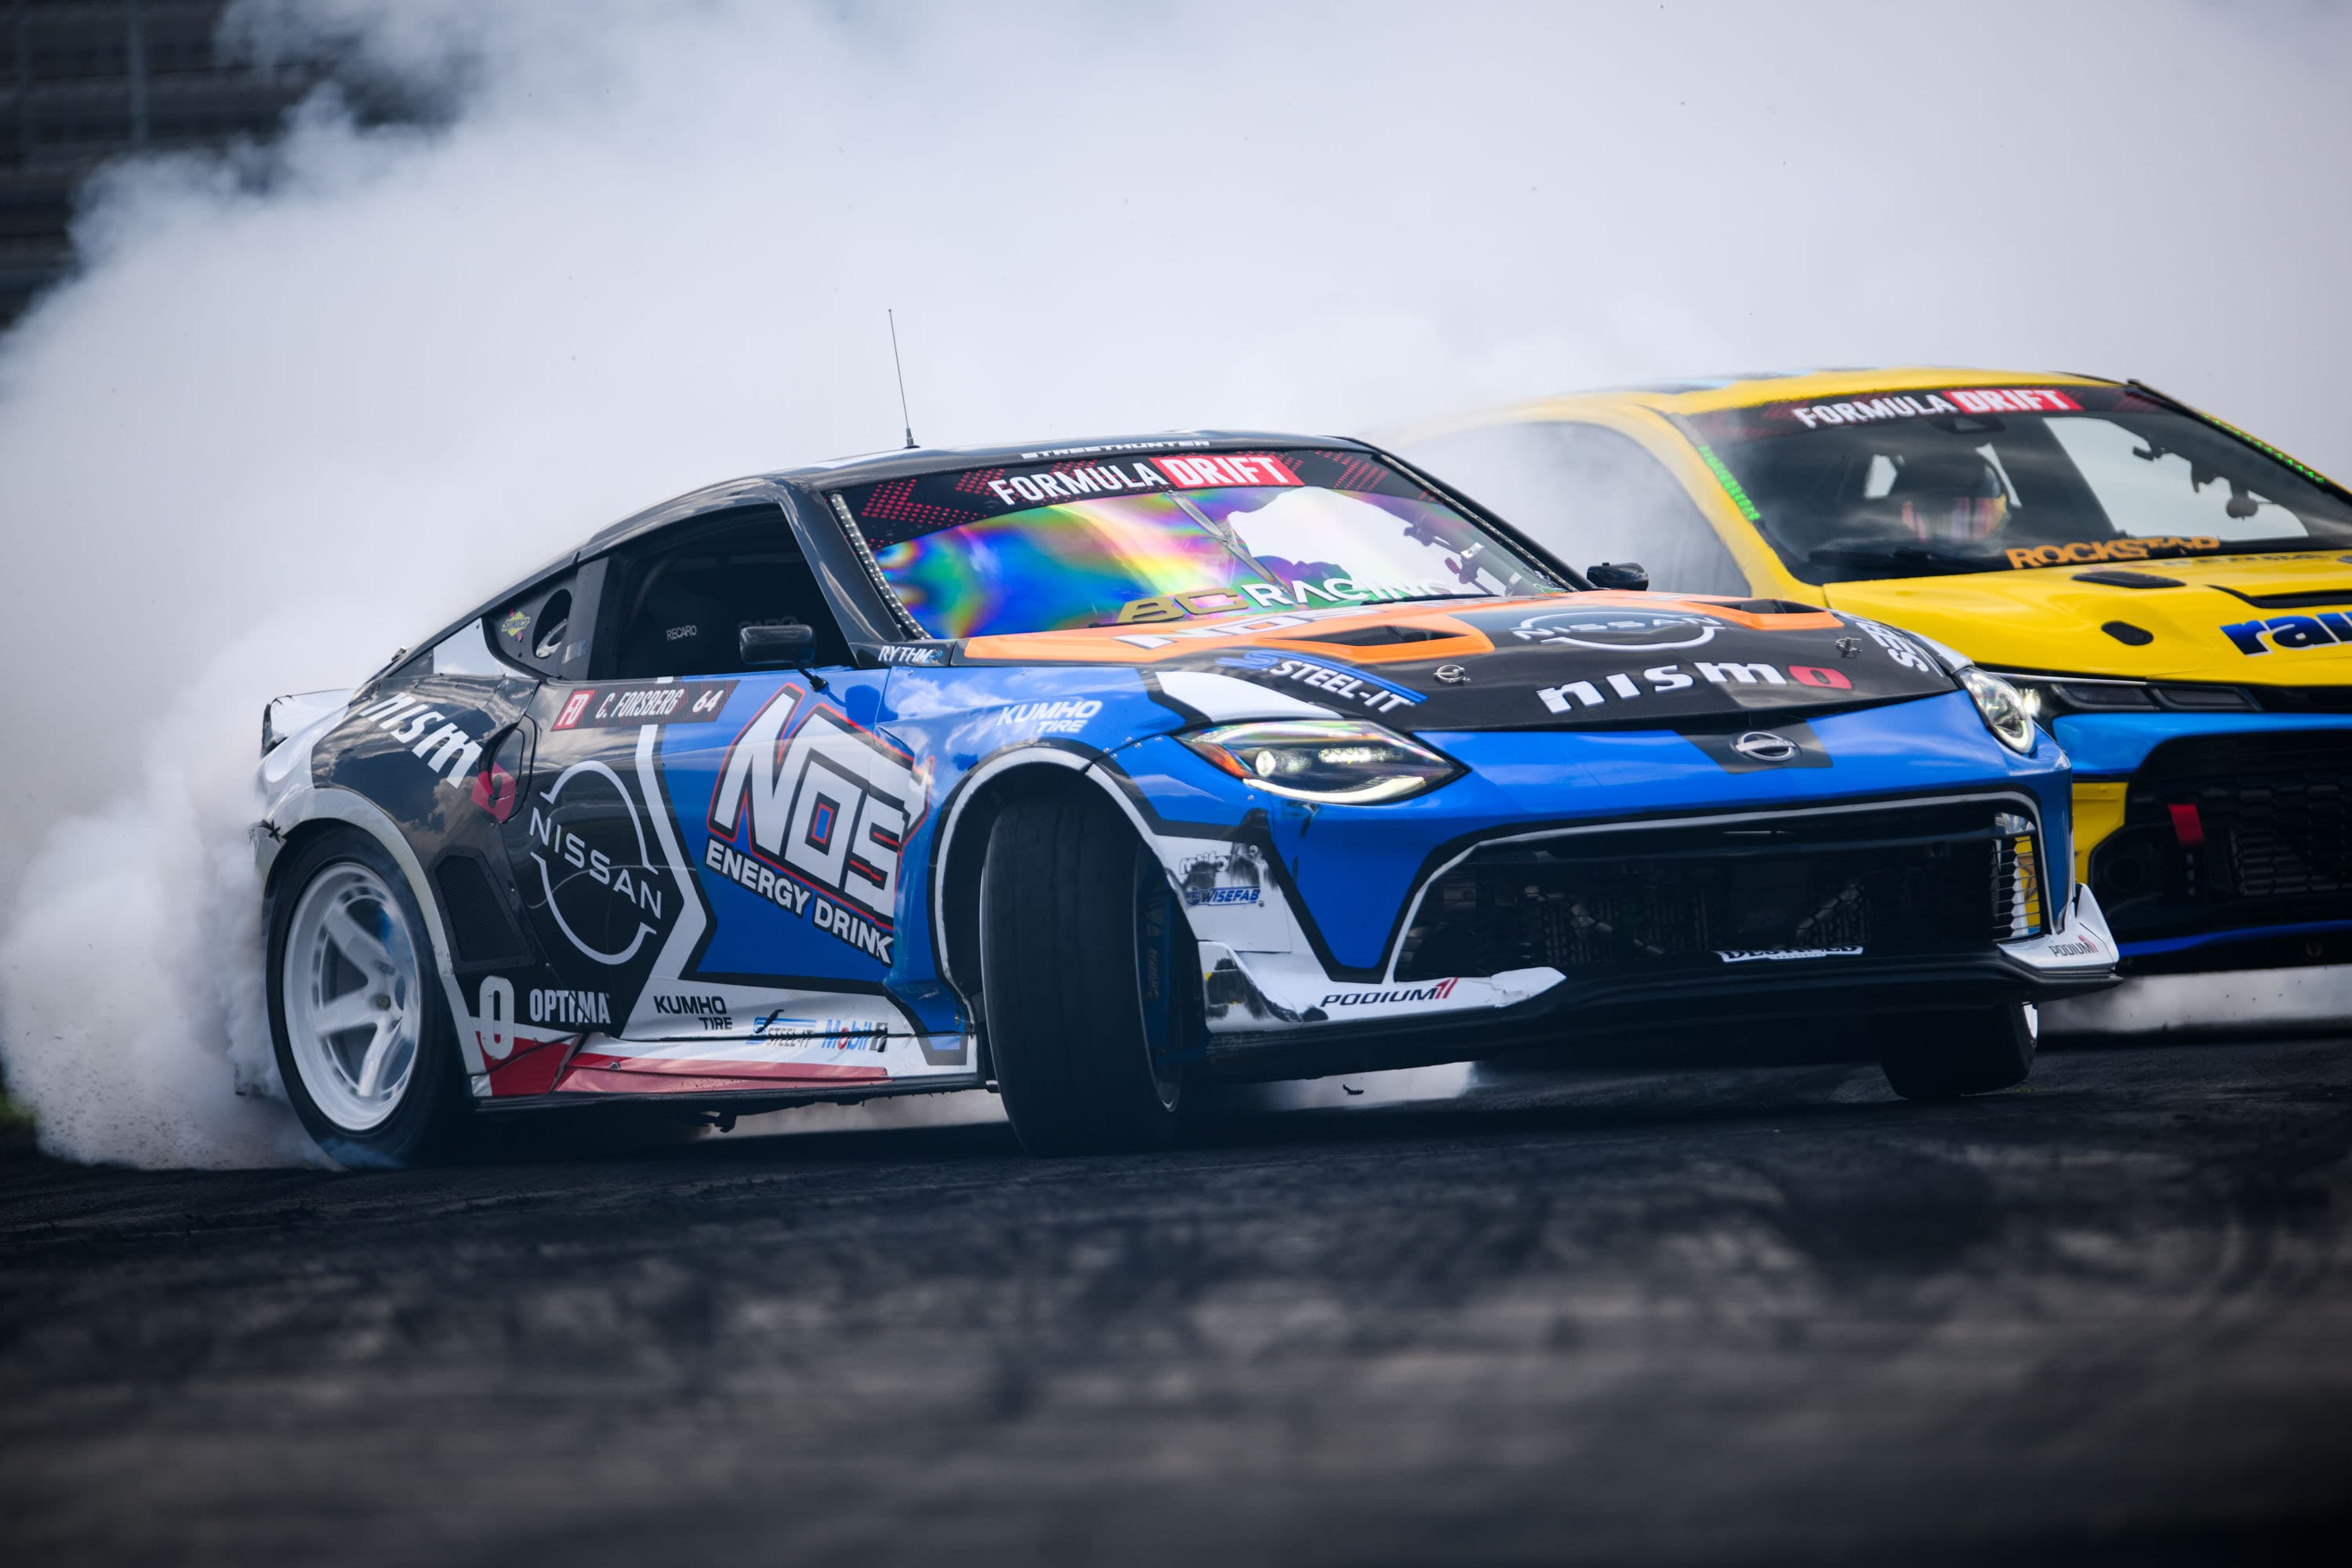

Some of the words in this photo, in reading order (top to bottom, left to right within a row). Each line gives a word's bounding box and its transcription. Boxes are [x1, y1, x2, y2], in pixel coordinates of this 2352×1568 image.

[1792, 394, 1959, 429] FORMULA
[1951, 389, 2071, 412] DRIFT
[1022, 441, 1210, 459] STREETHUNTER
[988, 462, 1171, 506] FORMULA
[1160, 456, 1289, 485] DRIFT
[1116, 588, 1248, 623] BC
[666, 625, 697, 641] RECARO
[1512, 616, 1722, 641] NISSAN
[2219, 612, 2352, 657] rai
[1269, 660, 1414, 713] STEEL-IT
[1535, 660, 1853, 715] nismo
[557, 693, 590, 726] FD
[595, 692, 615, 719] C.
[610, 688, 684, 717] FORSBERG
[692, 689, 724, 713] 64
[996, 700, 1103, 726] KUMHO
[1036, 720, 1087, 734] TIRE
[358, 691, 517, 823] nismo
[710, 687, 931, 924] NOS
[529, 807, 661, 920] NISSAN
[706, 838, 811, 915] ENERGY
[813, 897, 895, 964] DRINK
[529, 988, 612, 1025] OPTIMA
[653, 995, 727, 1015] KUMHO
[697, 1017, 733, 1031] TIRE
[822, 1018, 873, 1051] Mobil
